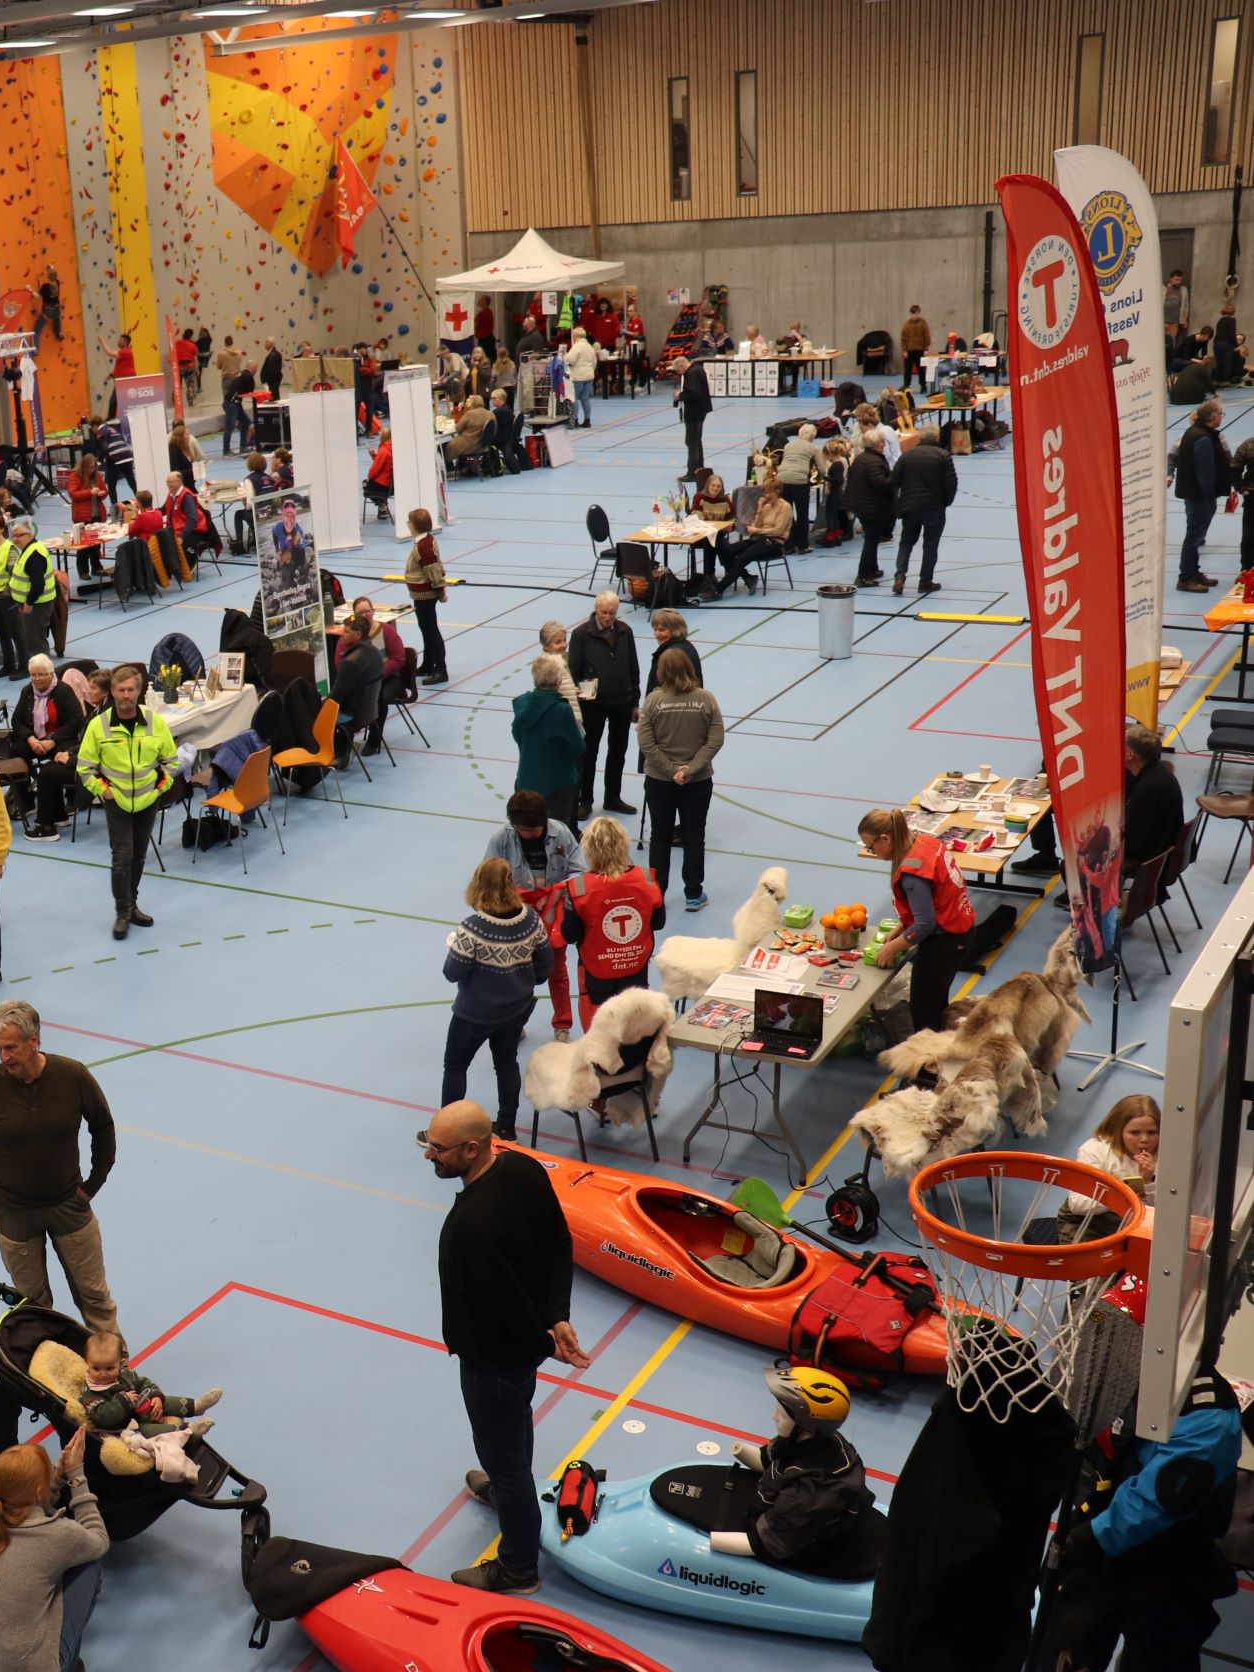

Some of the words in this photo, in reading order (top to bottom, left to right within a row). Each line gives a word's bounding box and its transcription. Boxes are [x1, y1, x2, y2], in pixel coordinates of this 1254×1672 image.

[137, 389, 155, 398] SOS
[612, 914, 633, 938] T
[612, 961, 639, 970] dnt.no
[608, 1242, 676, 1281] liquidlogic
[679, 1565, 766, 1596] liquidlogic
